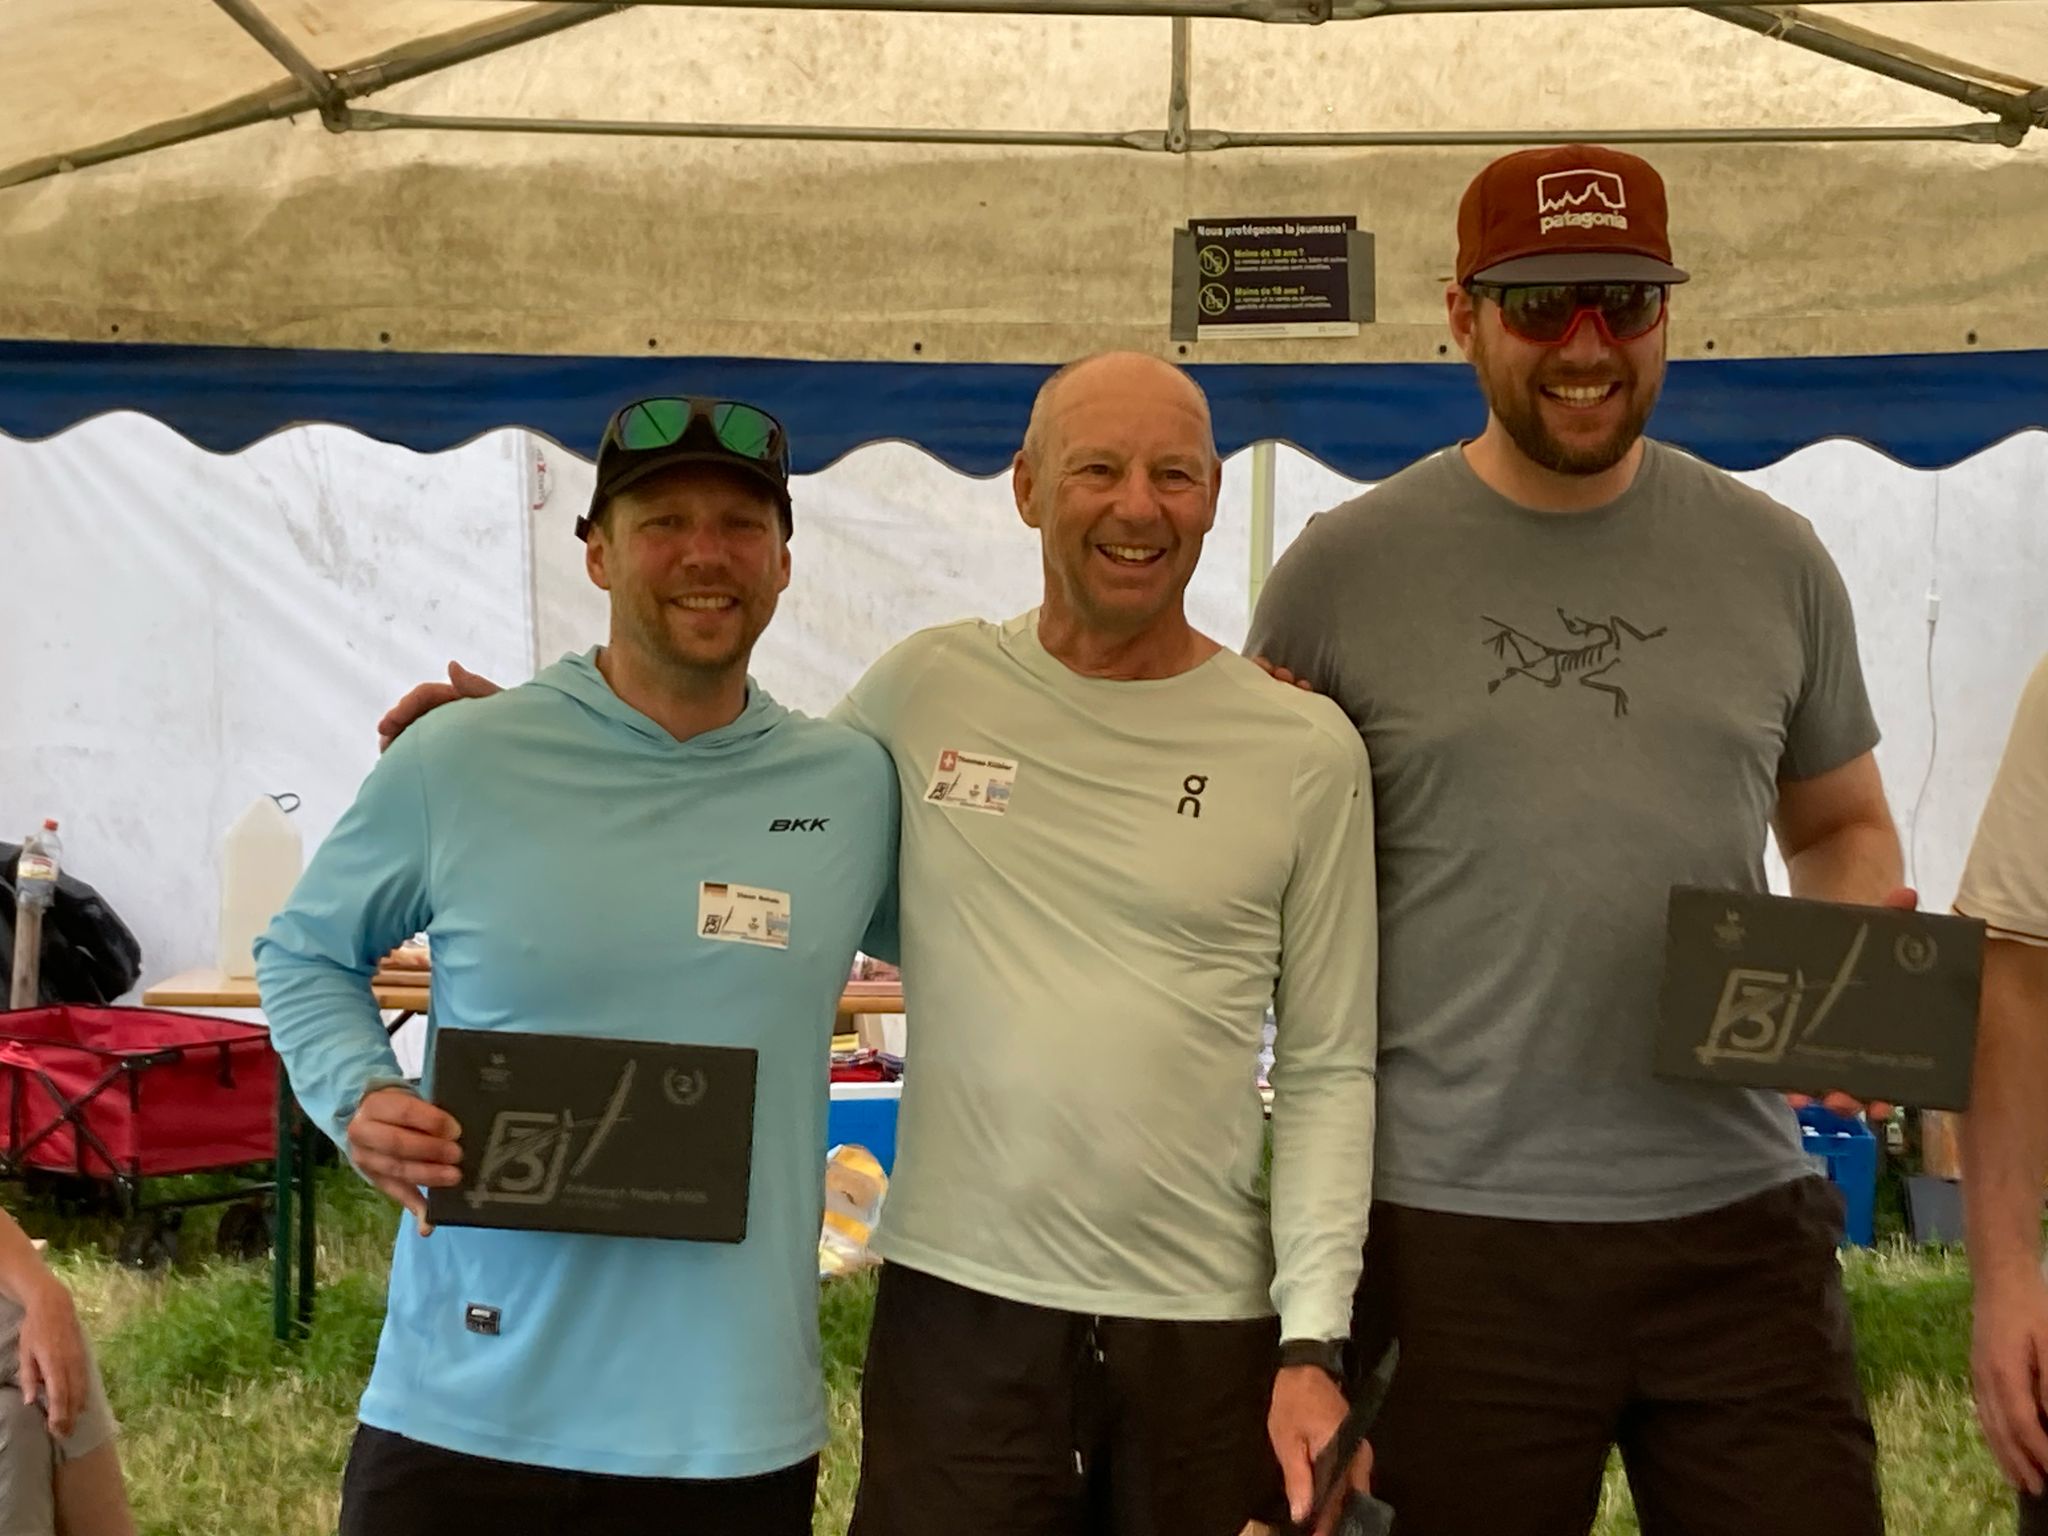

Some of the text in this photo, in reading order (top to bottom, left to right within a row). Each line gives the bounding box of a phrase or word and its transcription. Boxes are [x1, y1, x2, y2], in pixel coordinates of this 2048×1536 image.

[1540, 210, 1628, 235] patagonia
[1197, 225, 1223, 236] Nous
[769, 818, 831, 832] BKK
